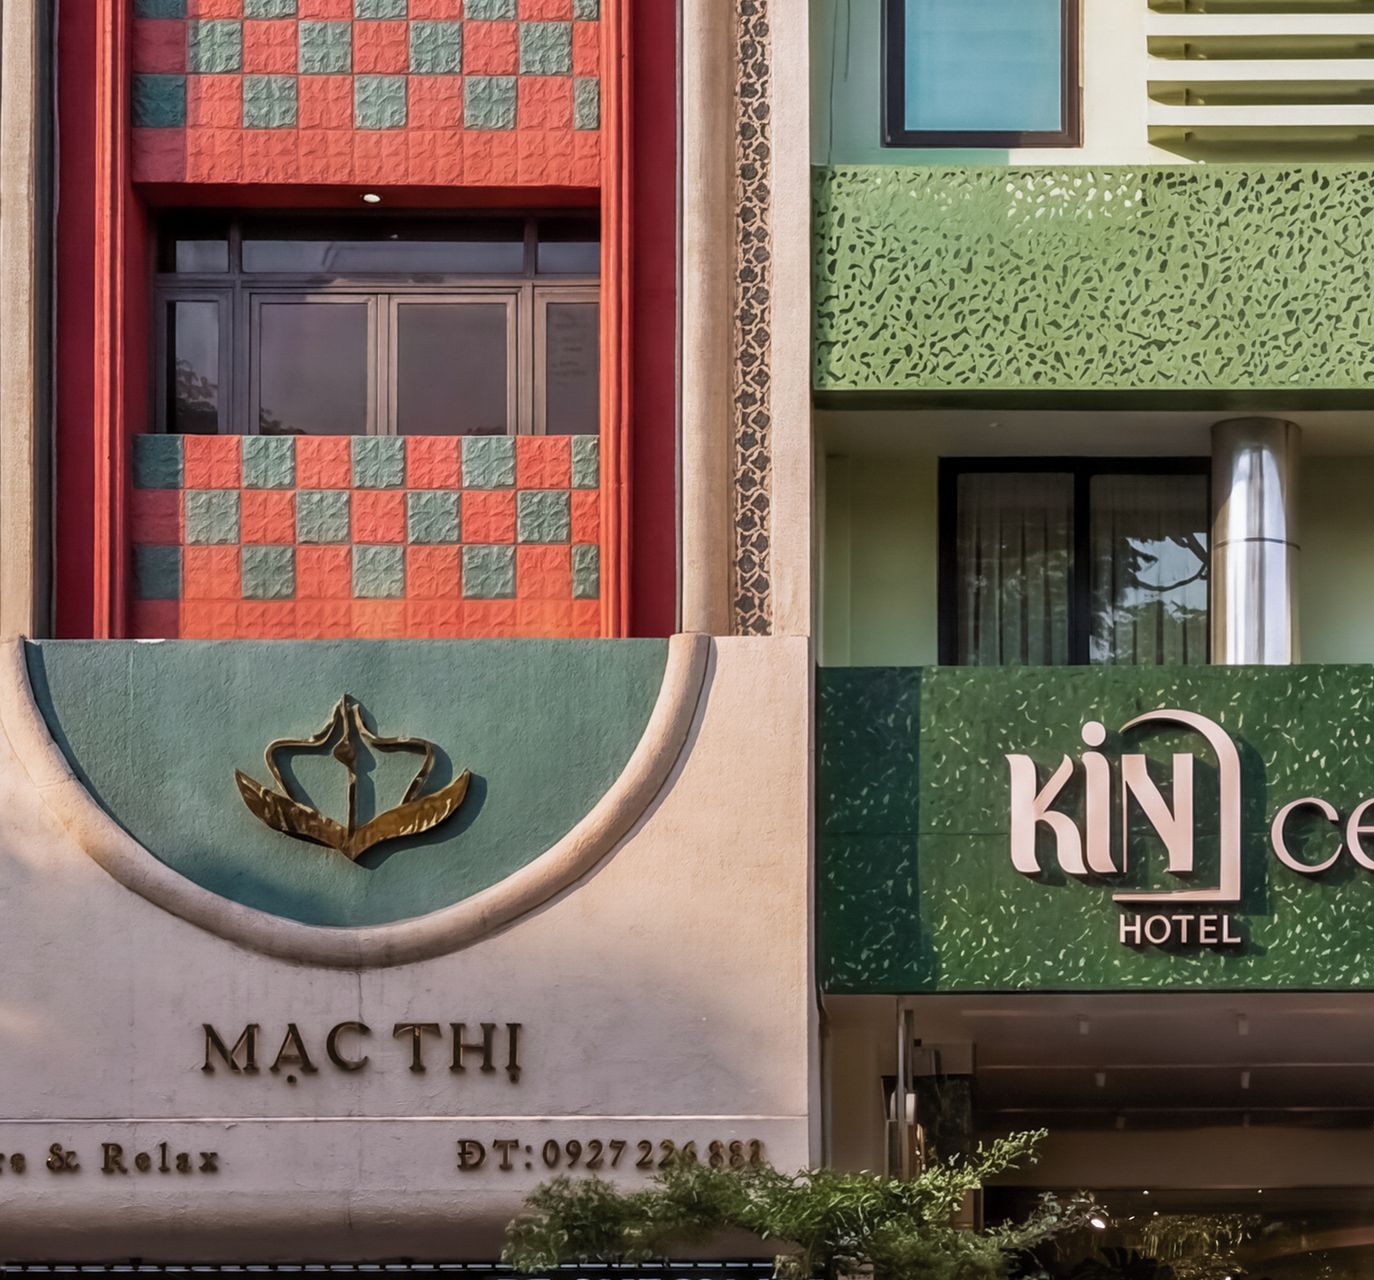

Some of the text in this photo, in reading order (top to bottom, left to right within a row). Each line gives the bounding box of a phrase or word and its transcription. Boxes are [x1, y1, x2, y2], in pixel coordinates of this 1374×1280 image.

[1118, 914, 1242, 945] HOTEL
[202, 1021, 523, 1084] MẠC THỊ
[47, 1143, 80, 1172] &
[100, 1142, 220, 1174] Relax
[457, 1139, 533, 1171] ĐT:
[542, 1139, 627, 1169] 0927
